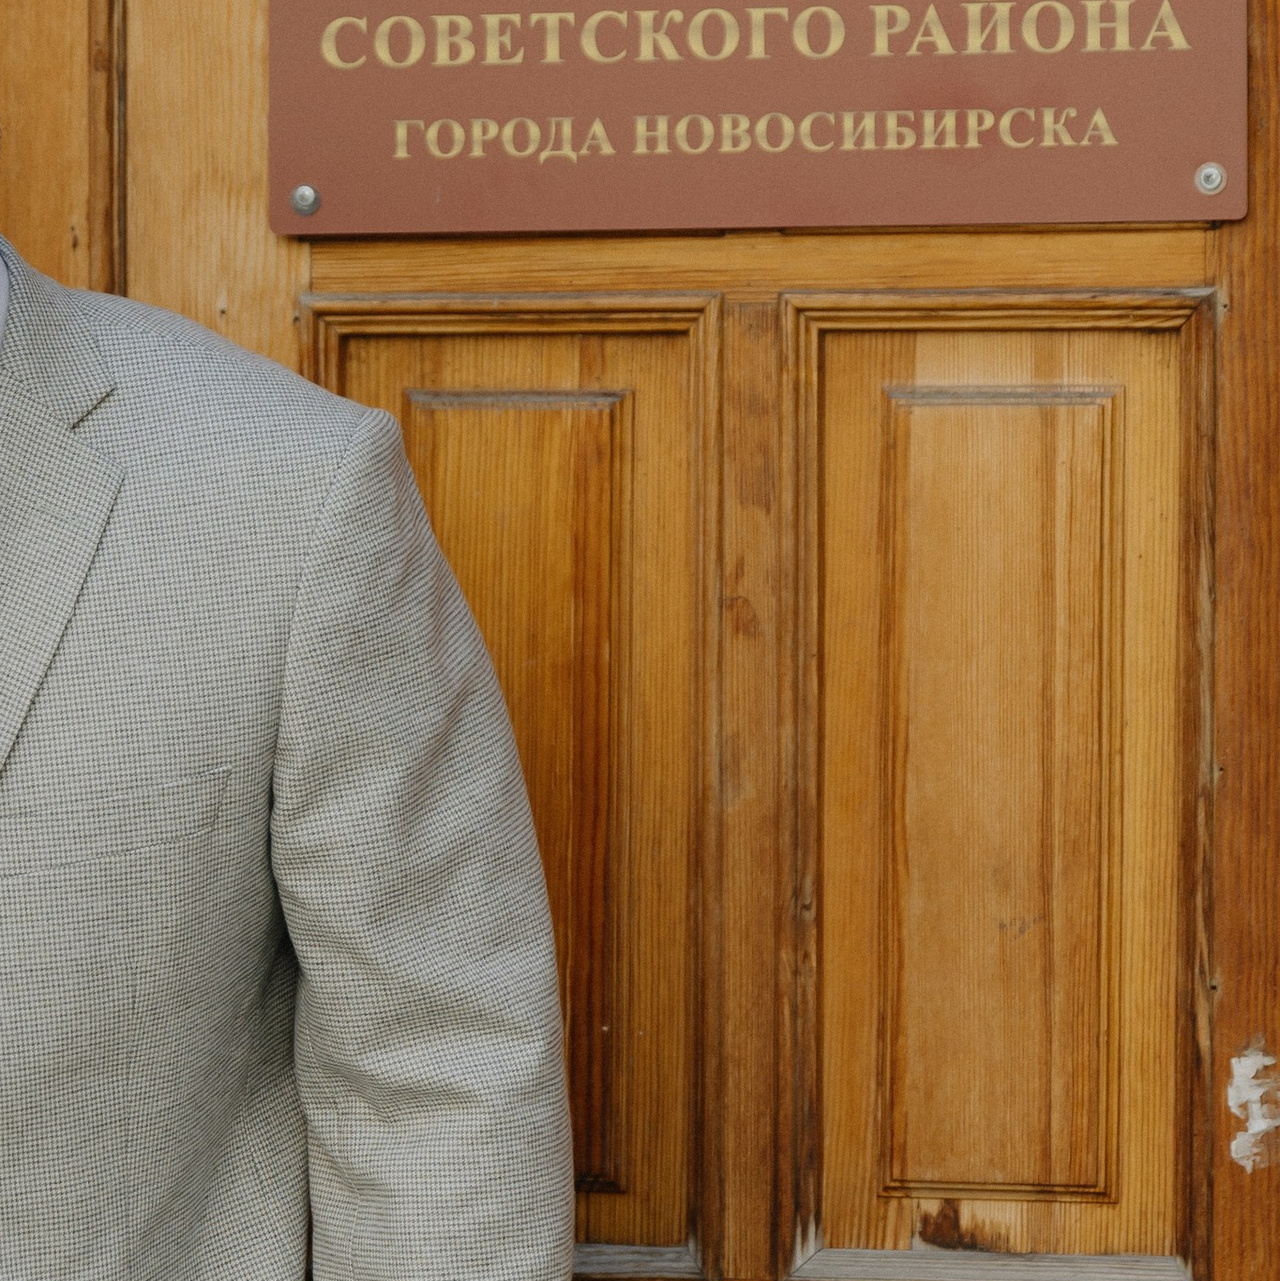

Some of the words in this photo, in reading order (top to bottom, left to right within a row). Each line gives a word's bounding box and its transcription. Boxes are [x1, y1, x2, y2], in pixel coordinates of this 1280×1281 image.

[321, 6, 845, 69] СОВЕТСКОГО
[394, 117, 615, 163] ГОРОДА
[634, 108, 1118, 155] НОВОСИБИРСКА
